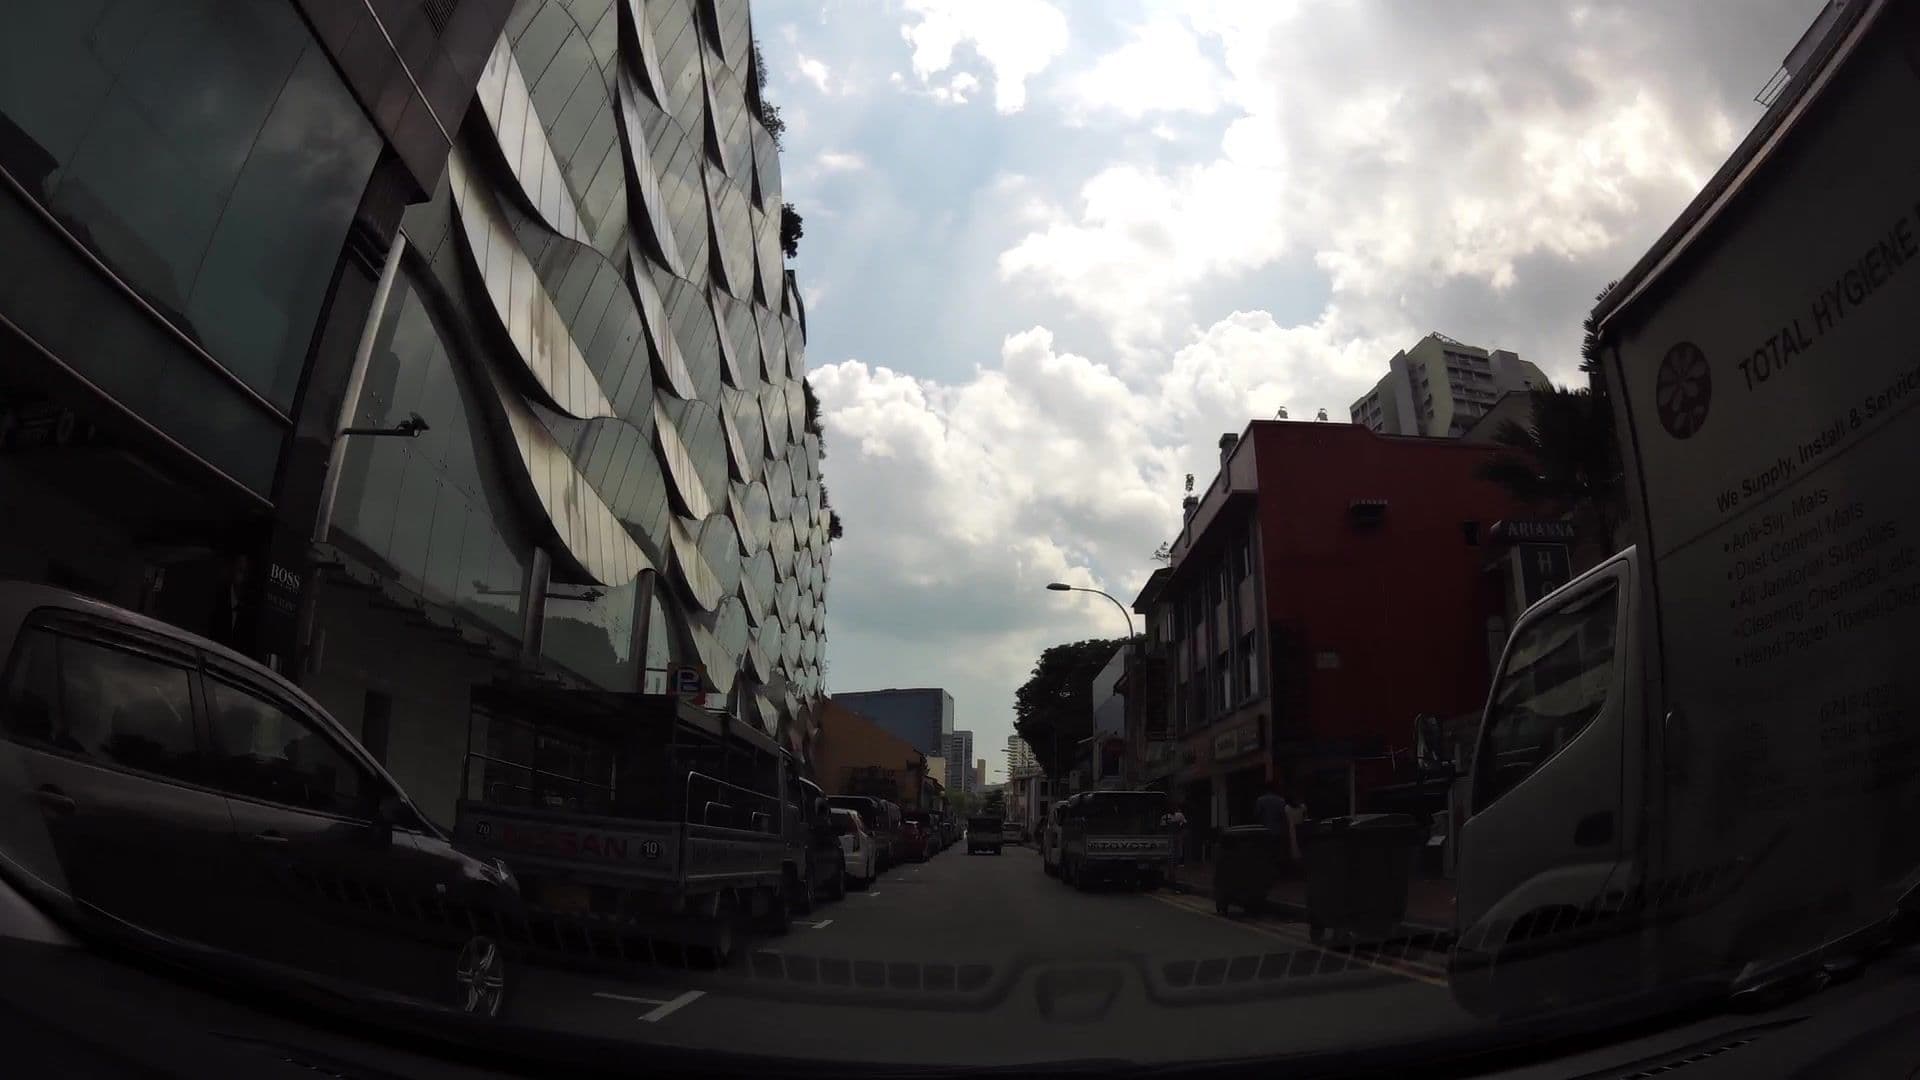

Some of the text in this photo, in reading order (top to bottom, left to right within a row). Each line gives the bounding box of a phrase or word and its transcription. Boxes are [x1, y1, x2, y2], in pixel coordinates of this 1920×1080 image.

[1738, 217, 1919, 392] TOTAL HYGIENE
[1716, 489, 1738, 513] We
[1798, 417, 1846, 464] Install
[1849, 408, 1862, 429] &
[1792, 489, 1829, 519] Mats
[1508, 521, 1575, 537] ARIANNA
[1736, 502, 1865, 580] Dust Control Mats
[271, 563, 300, 588] BOSS
[1740, 585, 1756, 607] All
[1742, 600, 1804, 639] Cleaning
[644, 842, 658, 854] 10
[1097, 840, 1158, 850] TOYOTA
